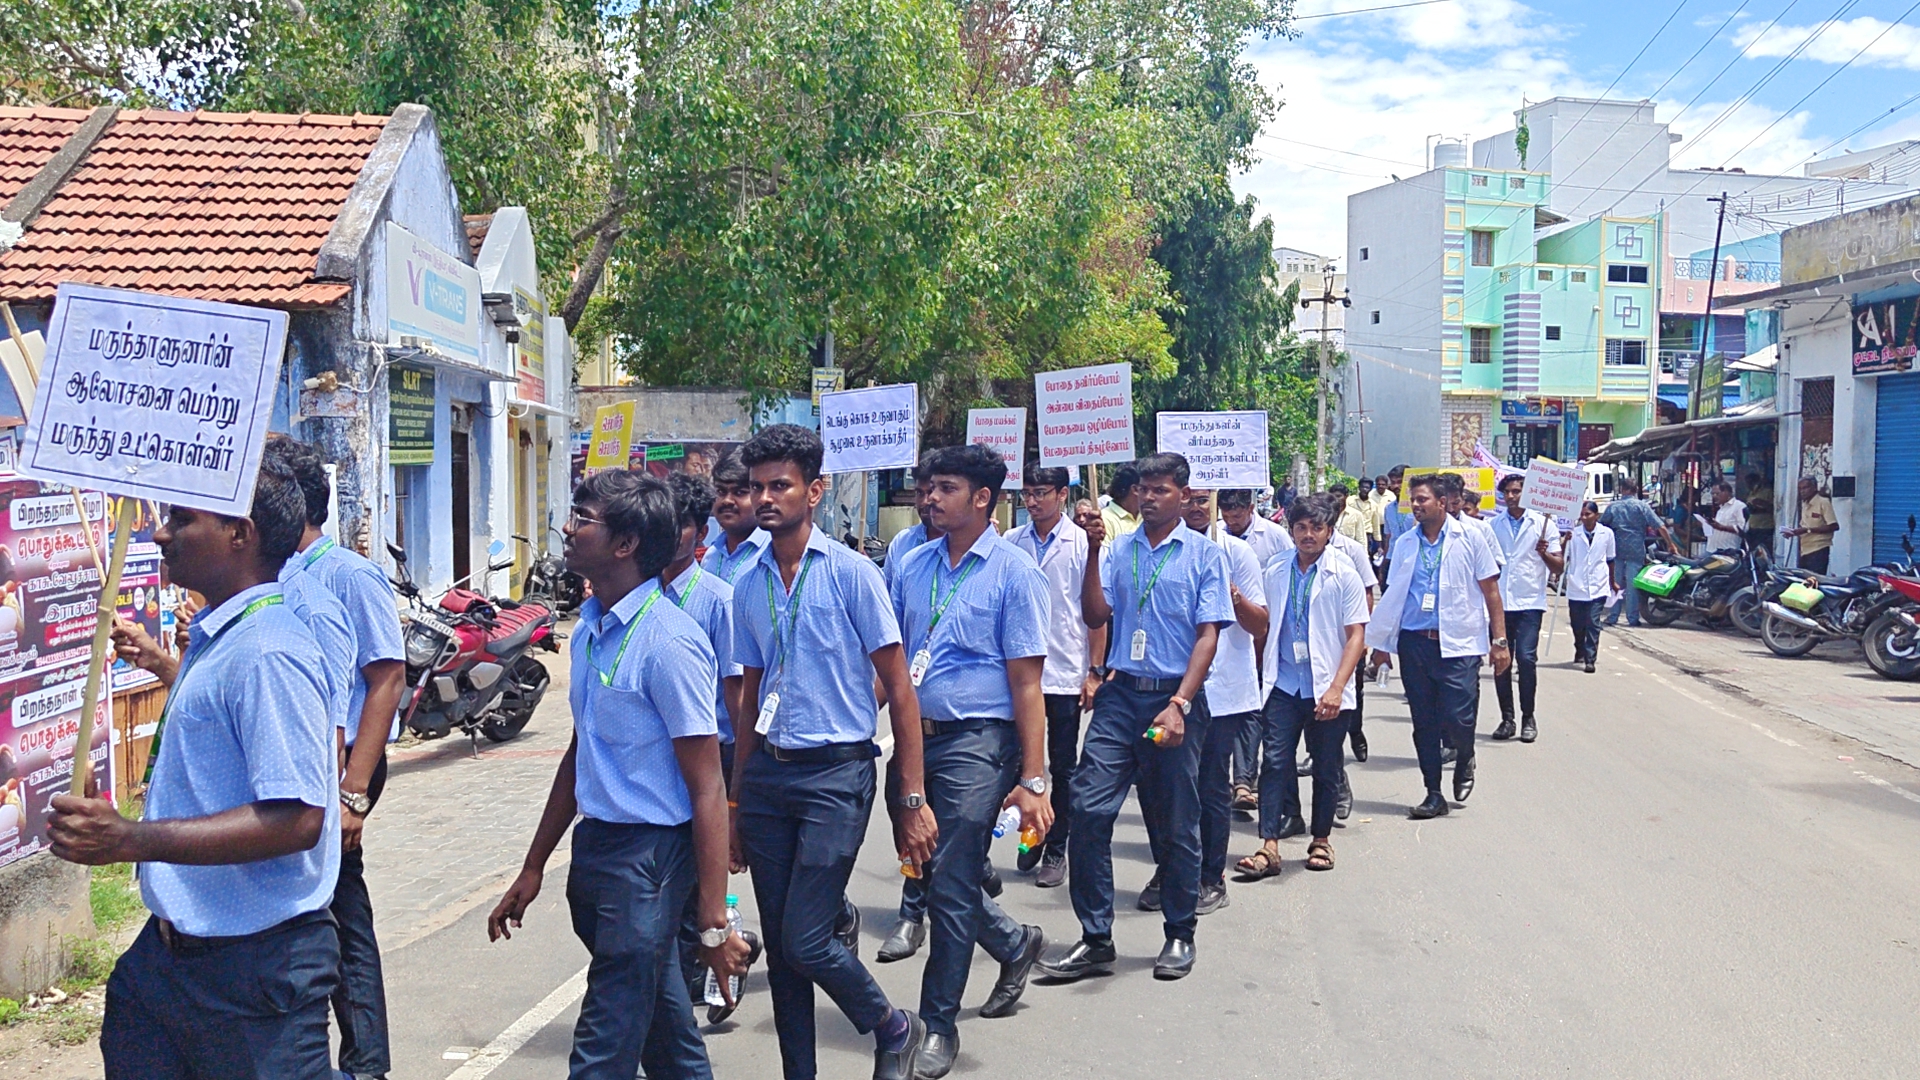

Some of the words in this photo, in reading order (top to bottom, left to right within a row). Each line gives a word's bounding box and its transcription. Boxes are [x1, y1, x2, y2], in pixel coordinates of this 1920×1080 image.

[427, 279, 464, 315] V-TRANS
[89, 320, 234, 369] மருந்தாளுனரின்
[403, 370, 421, 391] SLRT
[1045, 379, 1072, 392] போதை
[1074, 371, 1120, 390] தவிர்ப்போம்
[65, 370, 174, 412] ஆலோசனை
[177, 382, 241, 430] பெற்று
[1045, 401, 1074, 415] அன்பை
[1075, 393, 1124, 411] விதைப்போம்
[826, 411, 848, 428] டெங்கு
[850, 412, 870, 426] கொசு
[975, 416, 993, 426] போதை
[1044, 422, 1085, 436] போதையை
[1087, 415, 1128, 435] ஒழிப்போம்
[1180, 419, 1241, 432] மருந்துகளின்
[51, 416, 115, 461] மருந்து
[118, 433, 234, 472] உட்கொள்வீர்
[830, 435, 855, 453] சூழலை
[857, 427, 907, 450] உருவாக்காதீர்
[1086, 437, 1130, 456] திகழ்வோம்
[1188, 435, 1235, 447] வீரியத்தை
[1182, 452, 1260, 464] தாளுனர்களிடம்
[1196, 467, 1229, 481] அறிவீர்
[18, 498, 74, 525] பிறந்தநாள்
[20, 684, 77, 720] பிறந்தநாள்
[20, 705, 104, 752] பொதுக்கூம்
